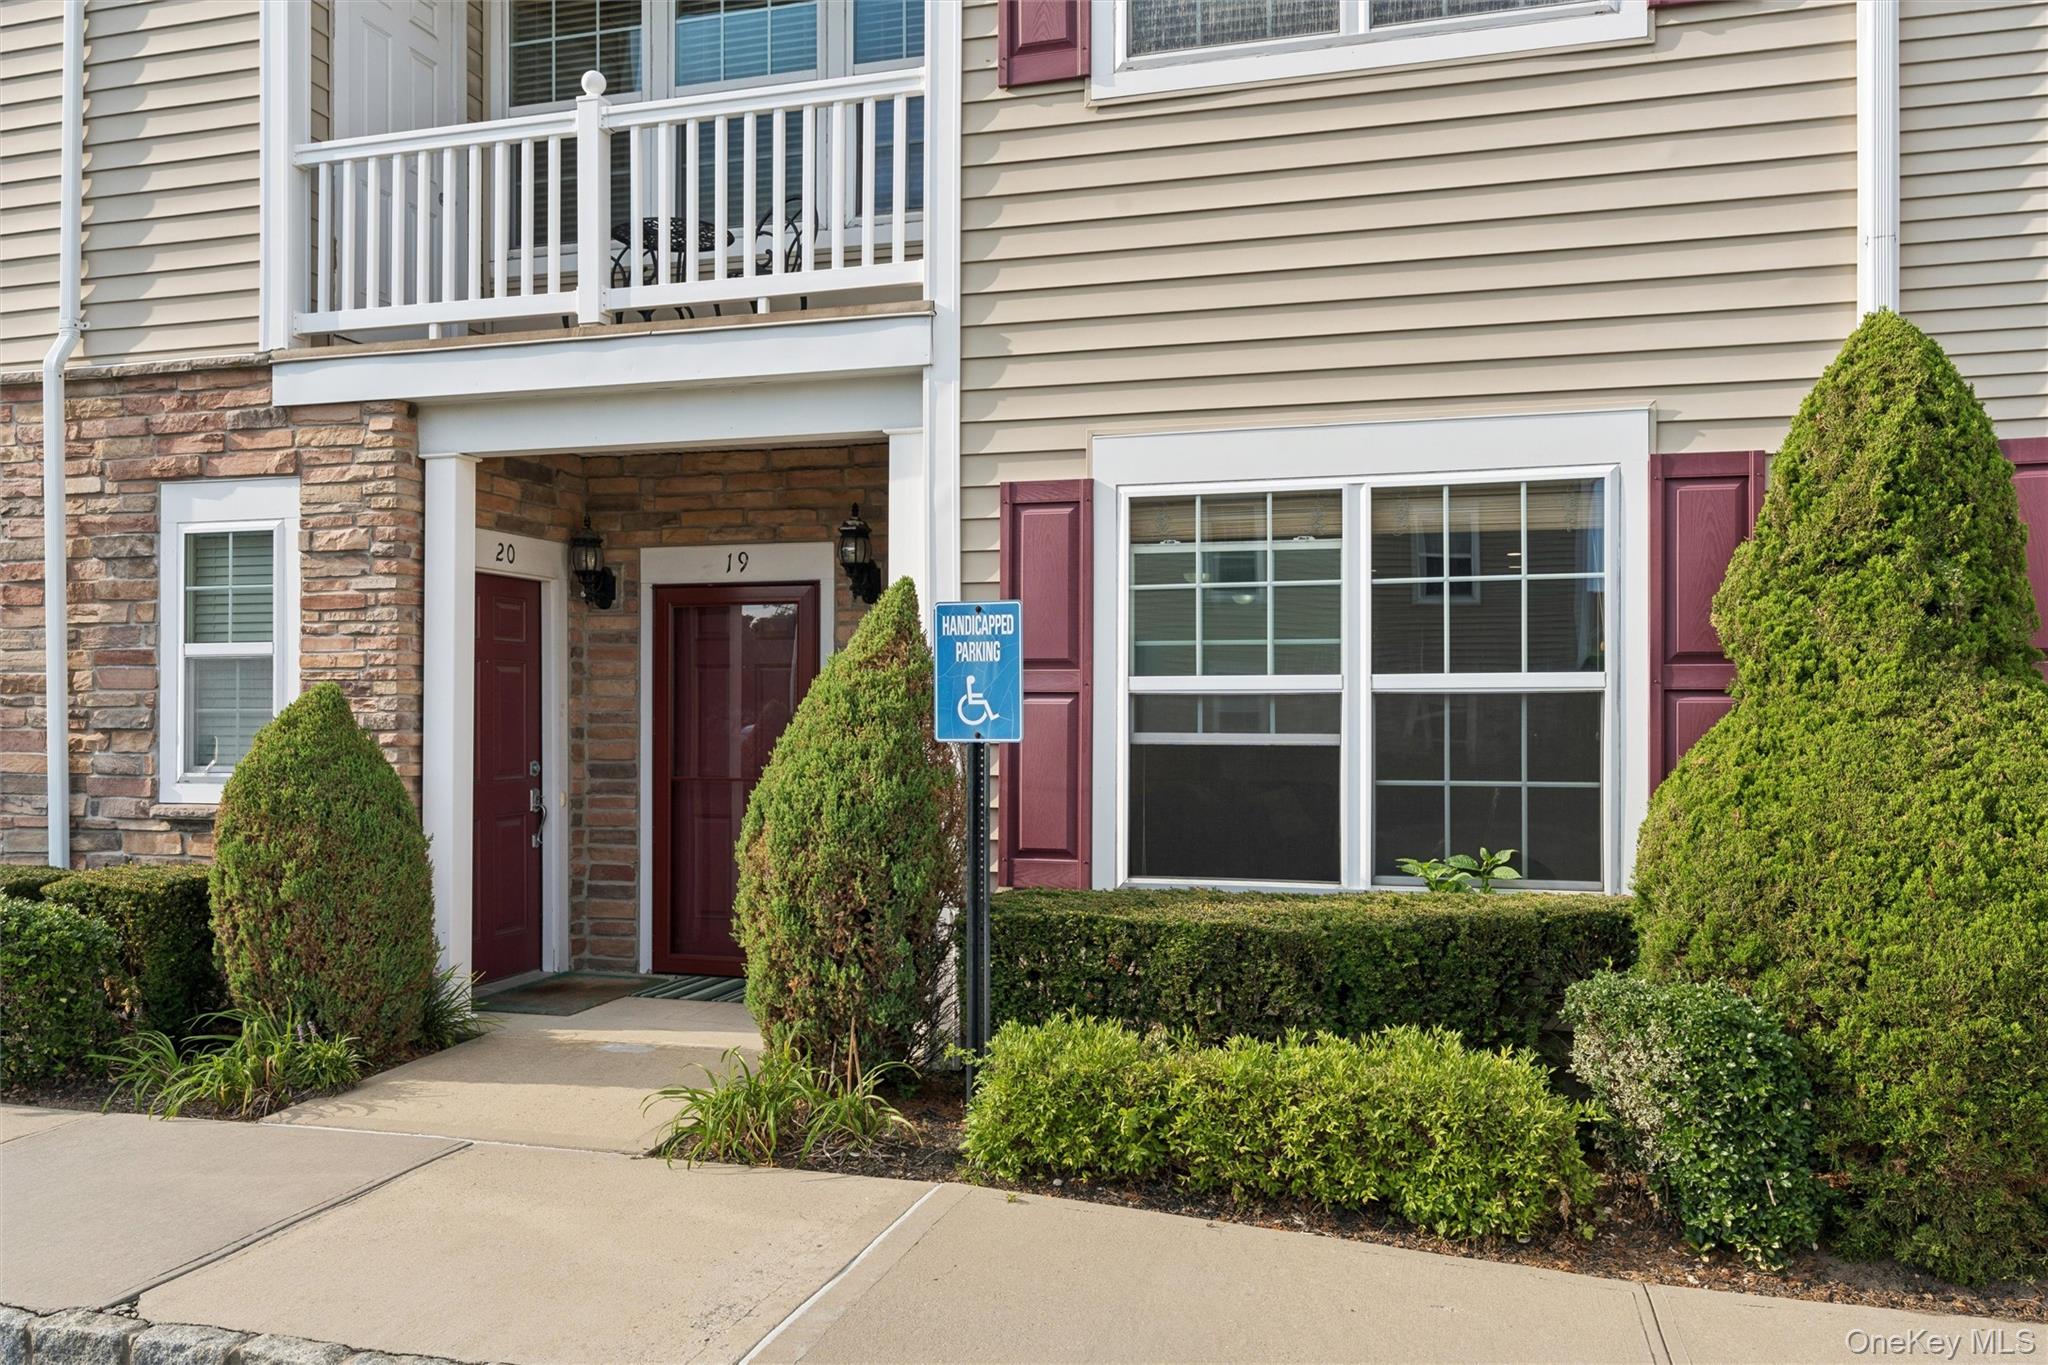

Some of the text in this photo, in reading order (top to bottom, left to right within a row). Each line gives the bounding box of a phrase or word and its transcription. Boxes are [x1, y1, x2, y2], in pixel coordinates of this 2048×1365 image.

[495, 542, 516, 565] 20
[726, 551, 749, 574] 19
[942, 614, 1014, 636] HANDICAPPED
[956, 641, 1001, 662] PARKING
